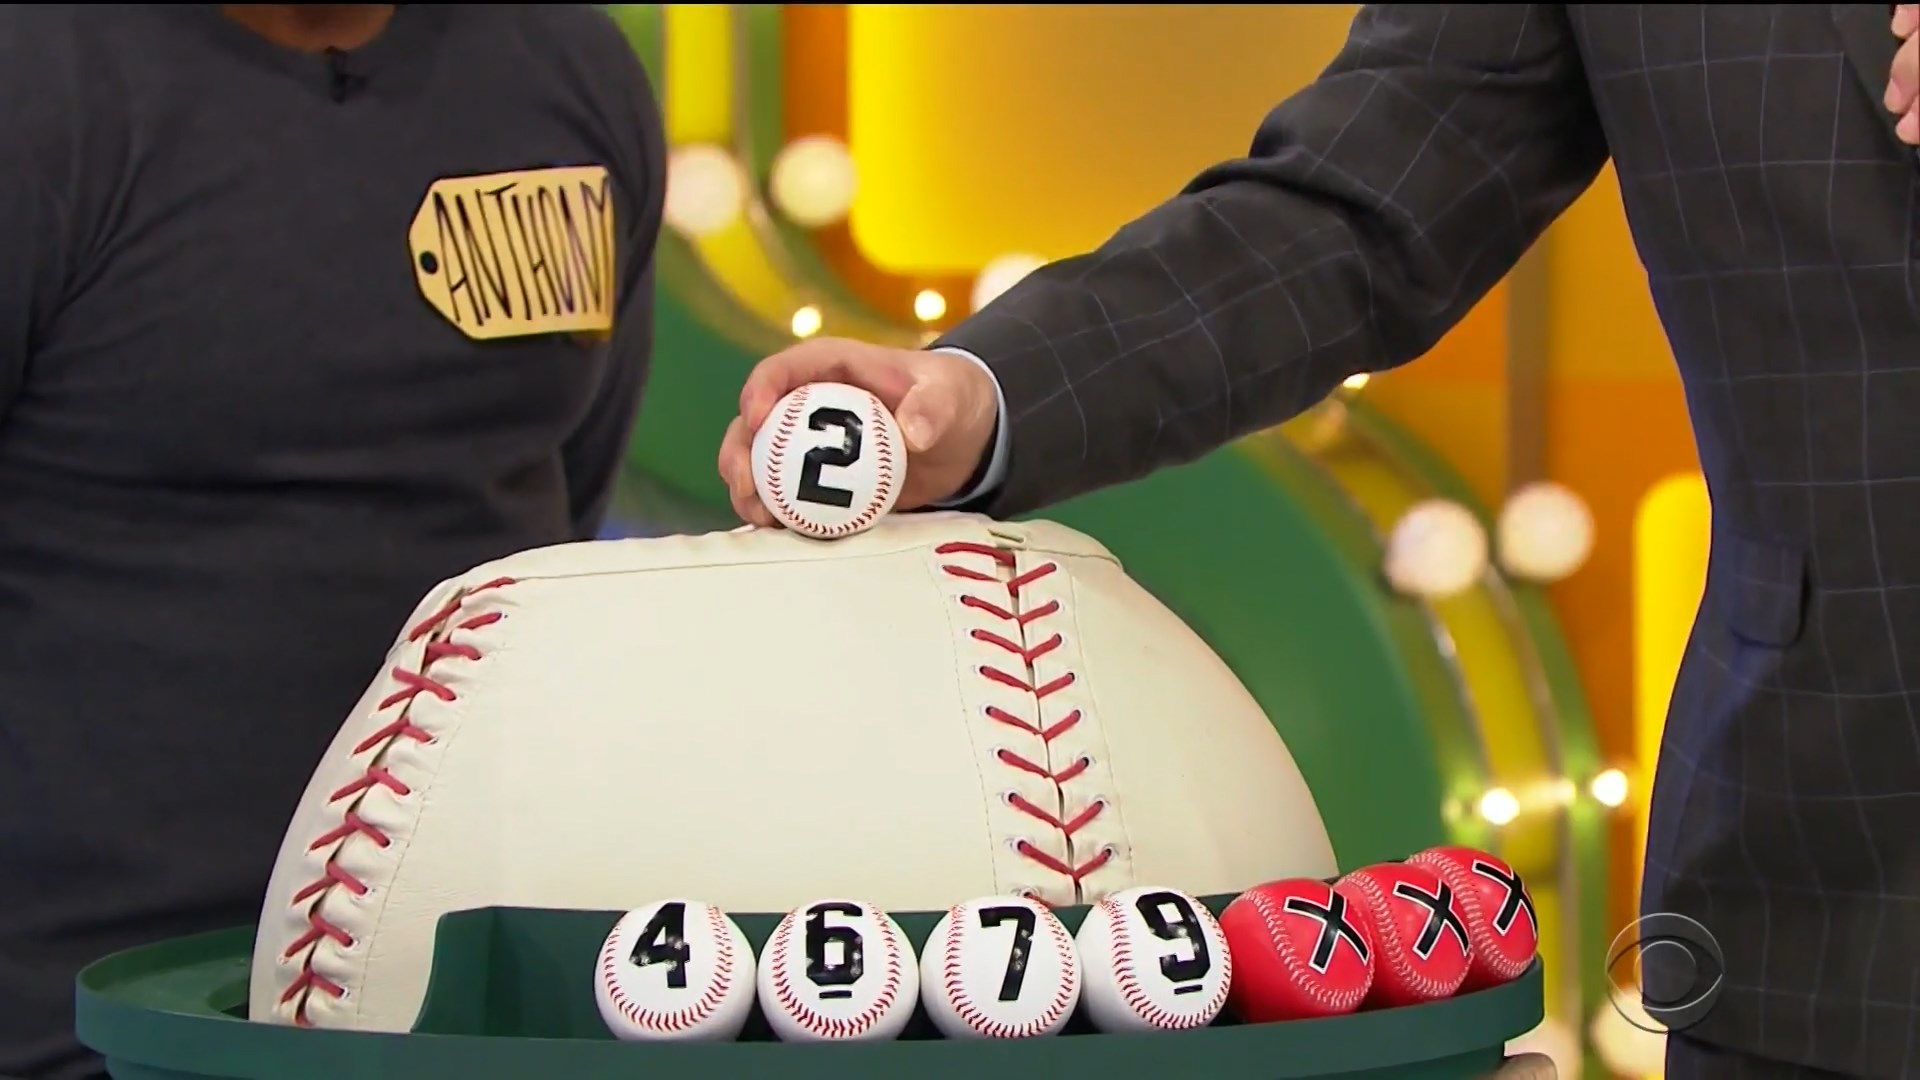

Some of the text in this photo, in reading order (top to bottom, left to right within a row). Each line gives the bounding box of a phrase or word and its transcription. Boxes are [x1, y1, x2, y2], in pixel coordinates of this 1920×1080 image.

[432, 175, 613, 326] ANTHONY
[797, 406, 863, 508] 2
[629, 902, 690, 989] 4
[805, 902, 863, 985] 6
[979, 905, 1036, 1001] 7
[1135, 891, 1211, 983] 9
[1284, 887, 1373, 974] X
[1394, 880, 1471, 960] X
